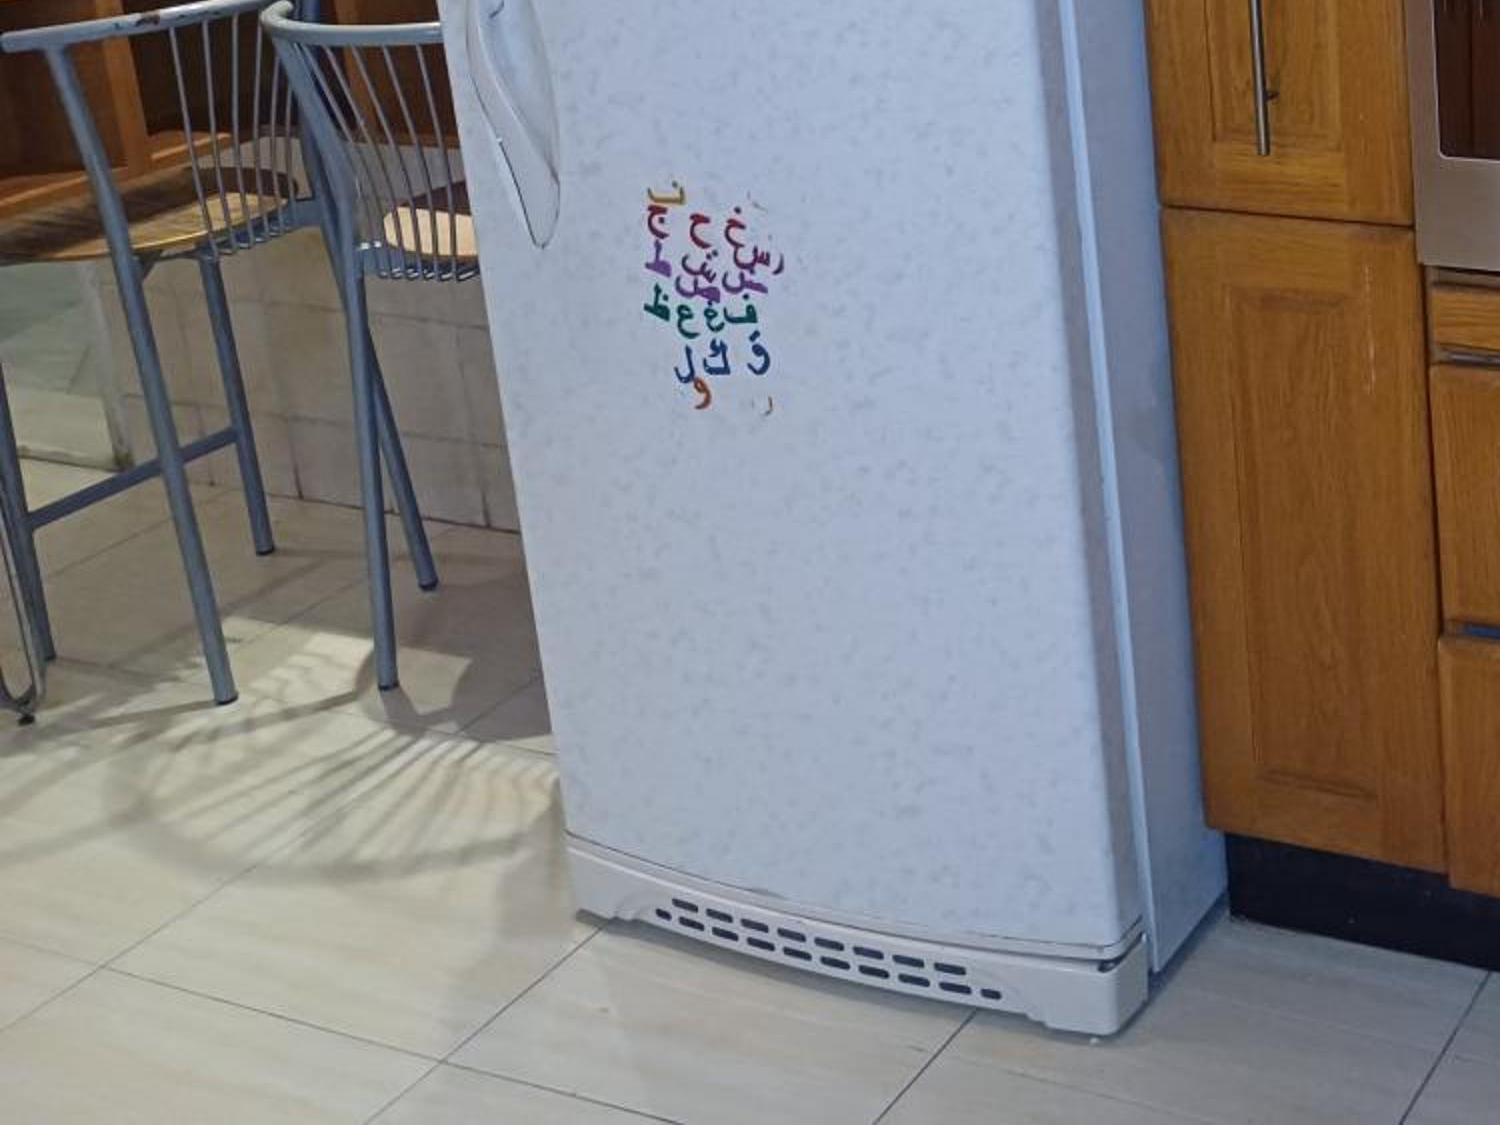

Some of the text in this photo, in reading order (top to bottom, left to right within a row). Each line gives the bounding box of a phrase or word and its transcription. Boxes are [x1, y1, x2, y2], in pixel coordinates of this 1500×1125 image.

[647, 205, 747, 248] ج ح خ
[643, 283, 758, 339] ظ ع غ ف
[674, 331, 771, 384] ل ك ق
[693, 378, 713, 410] و
